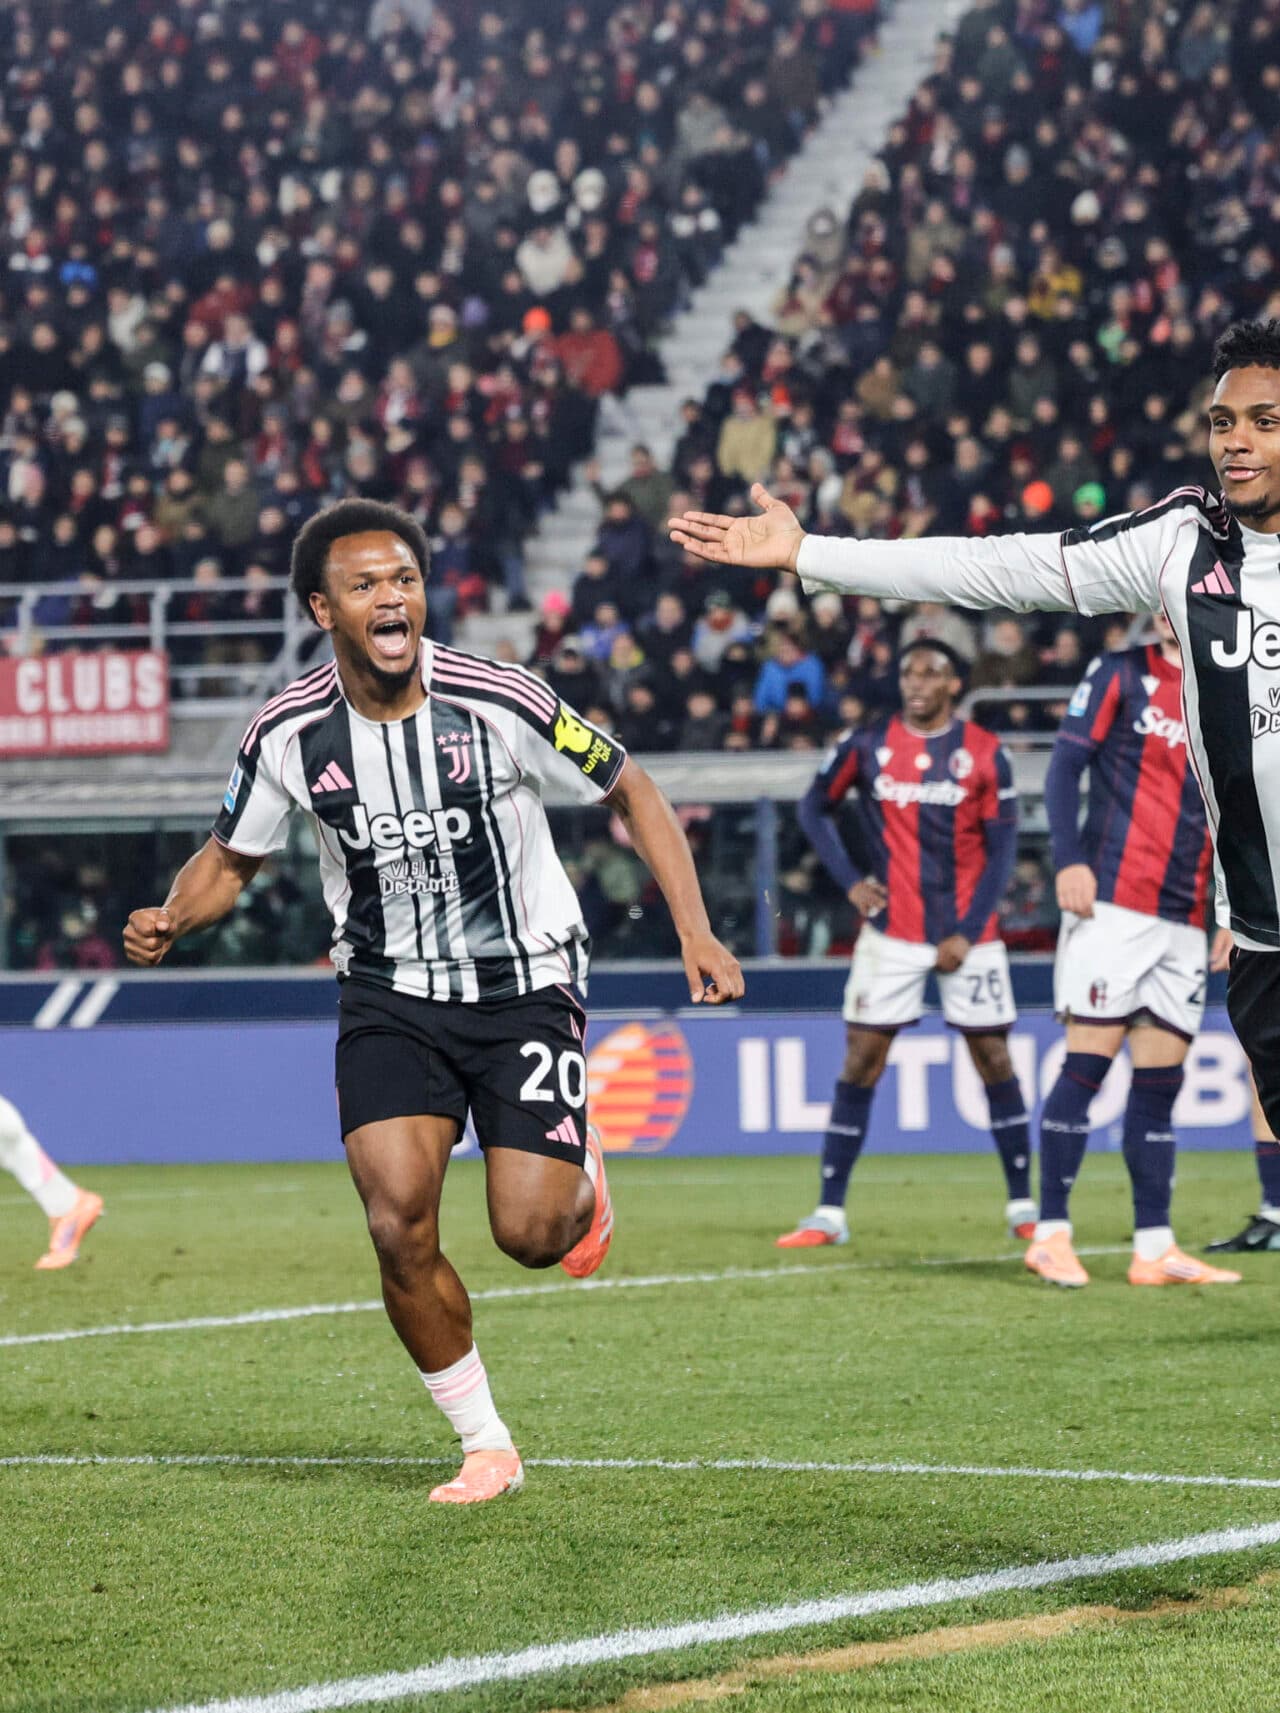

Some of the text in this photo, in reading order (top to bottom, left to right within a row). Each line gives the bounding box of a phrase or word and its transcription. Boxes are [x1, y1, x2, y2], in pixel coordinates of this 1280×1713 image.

[16, 653, 165, 714] CLUBS
[1133, 705, 1187, 748] Sap
[338, 803, 471, 853] Jeep
[380, 872, 461, 898] Detroit
[391, 859, 436, 877] VISIT
[966, 968, 1001, 1004] 26
[519, 1041, 587, 1109] 20
[738, 1037, 832, 1133] IL
